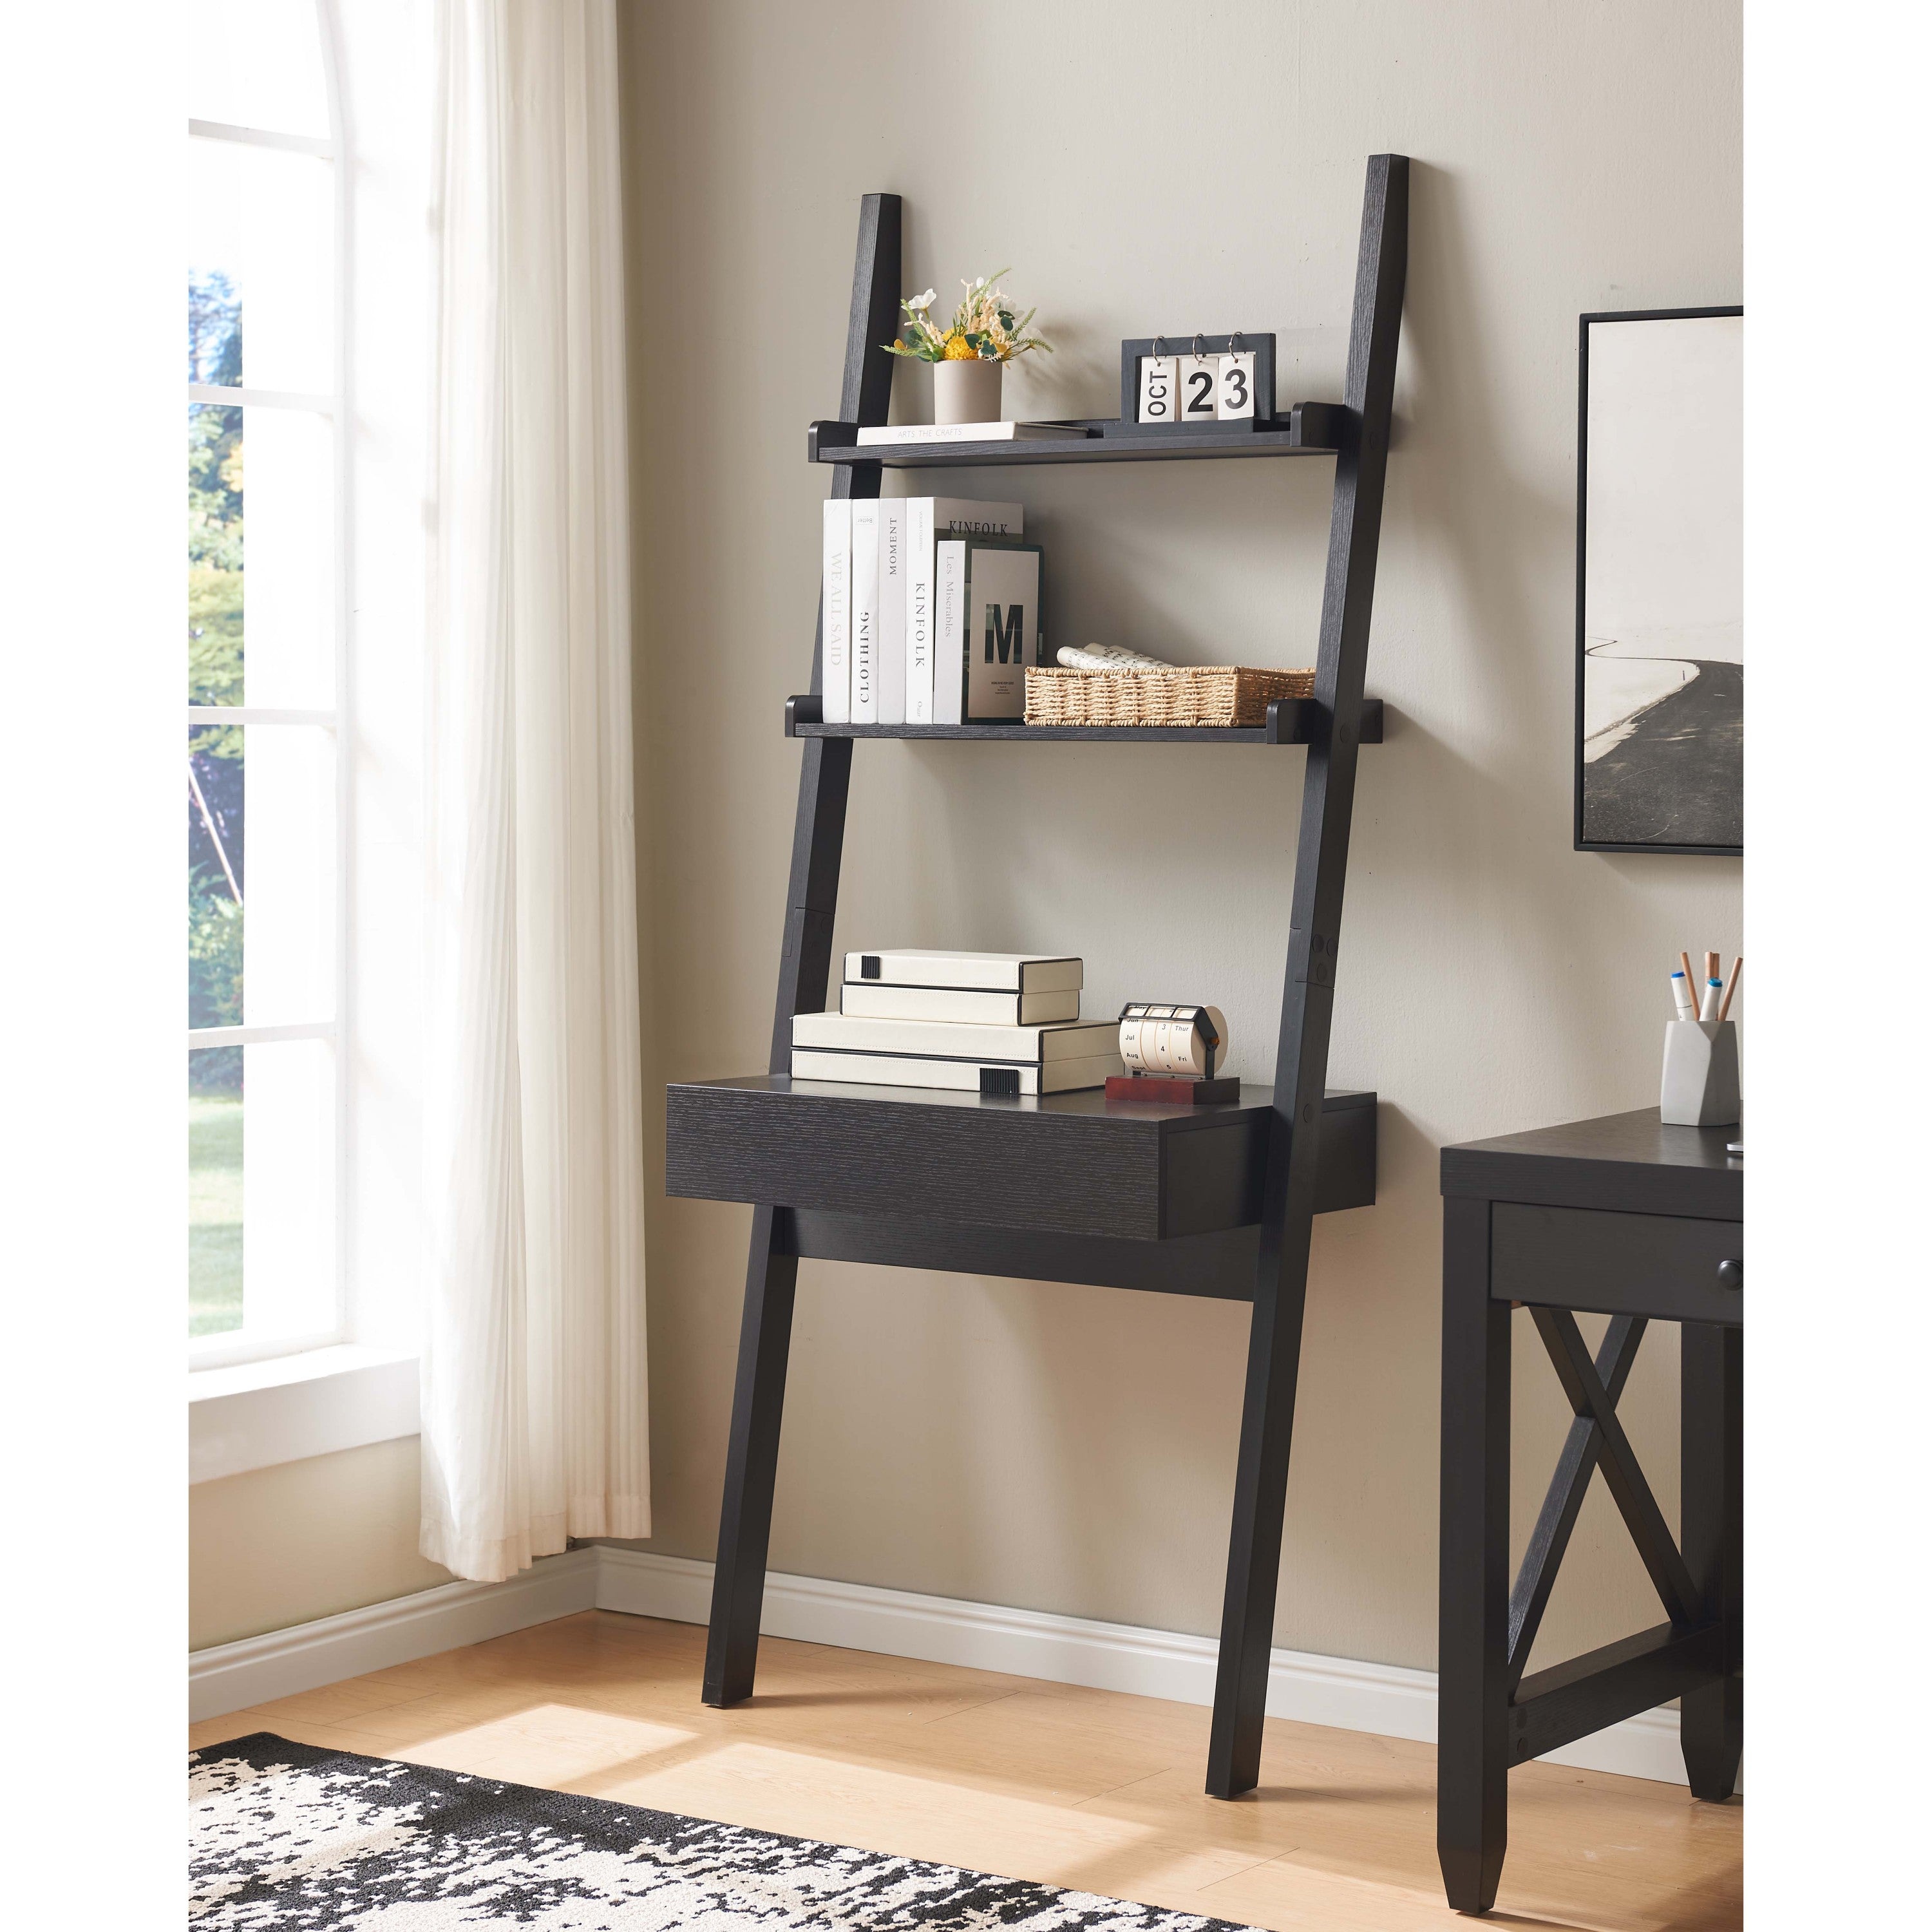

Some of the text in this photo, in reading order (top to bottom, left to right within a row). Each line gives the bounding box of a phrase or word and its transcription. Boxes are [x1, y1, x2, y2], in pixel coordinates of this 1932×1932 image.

[1148, 370, 1168, 416] OCT
[936, 428, 962, 437] CRAFTS
[889, 517, 897, 576] MOMENT
[949, 520, 1008, 536] KINFOLK
[831, 551, 842, 666] WE ALL SAID
[915, 582, 925, 667] KINFOLK
[945, 582, 954, 638] Miserables
[984, 603, 1024, 665] M
[860, 611, 869, 704] CLOTHING
